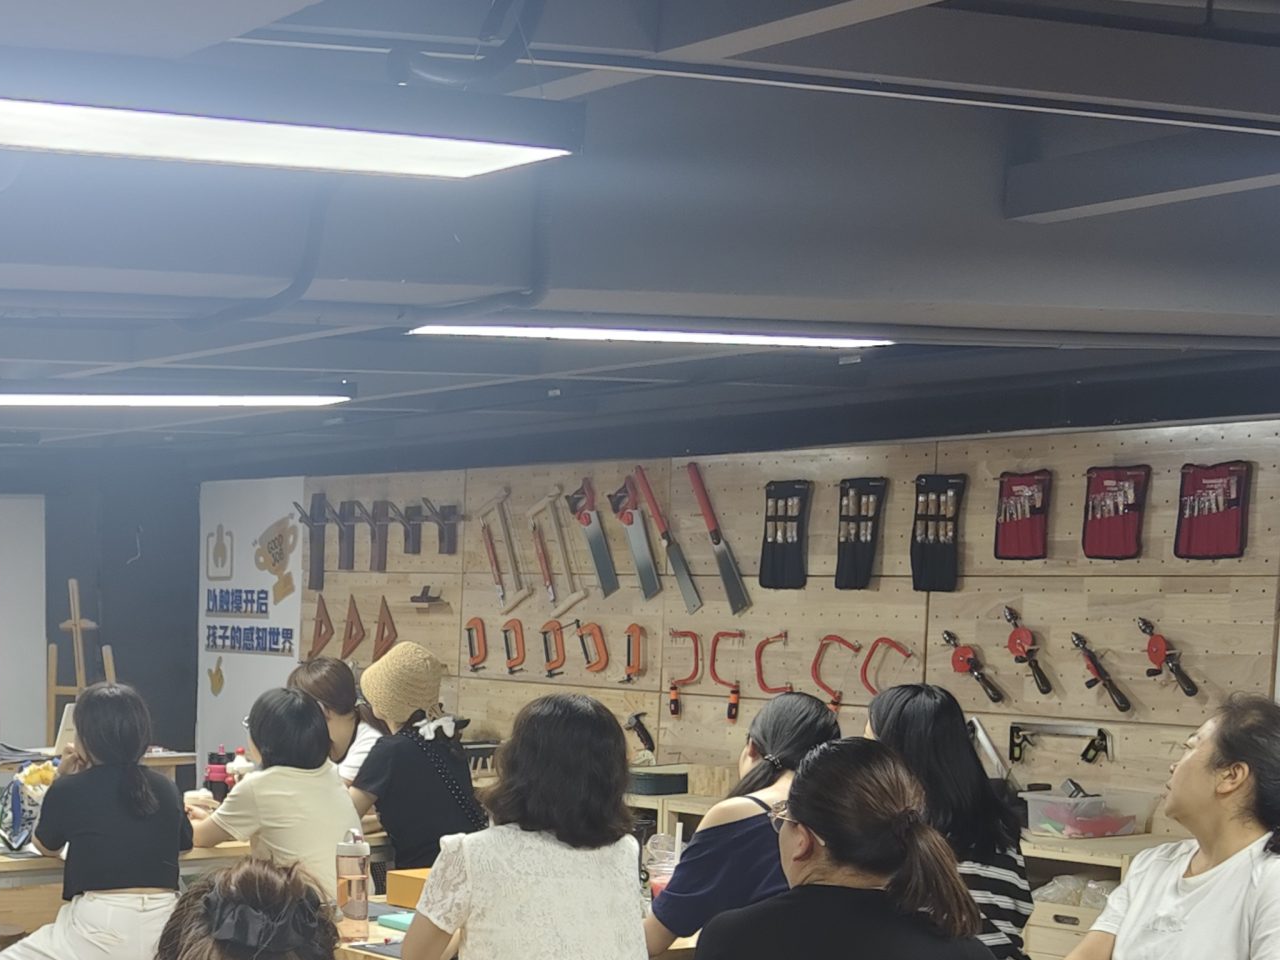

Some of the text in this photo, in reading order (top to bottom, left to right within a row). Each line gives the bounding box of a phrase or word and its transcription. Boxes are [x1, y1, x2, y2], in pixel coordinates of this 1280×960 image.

[206, 625, 294, 653] 孩子的感知世界
